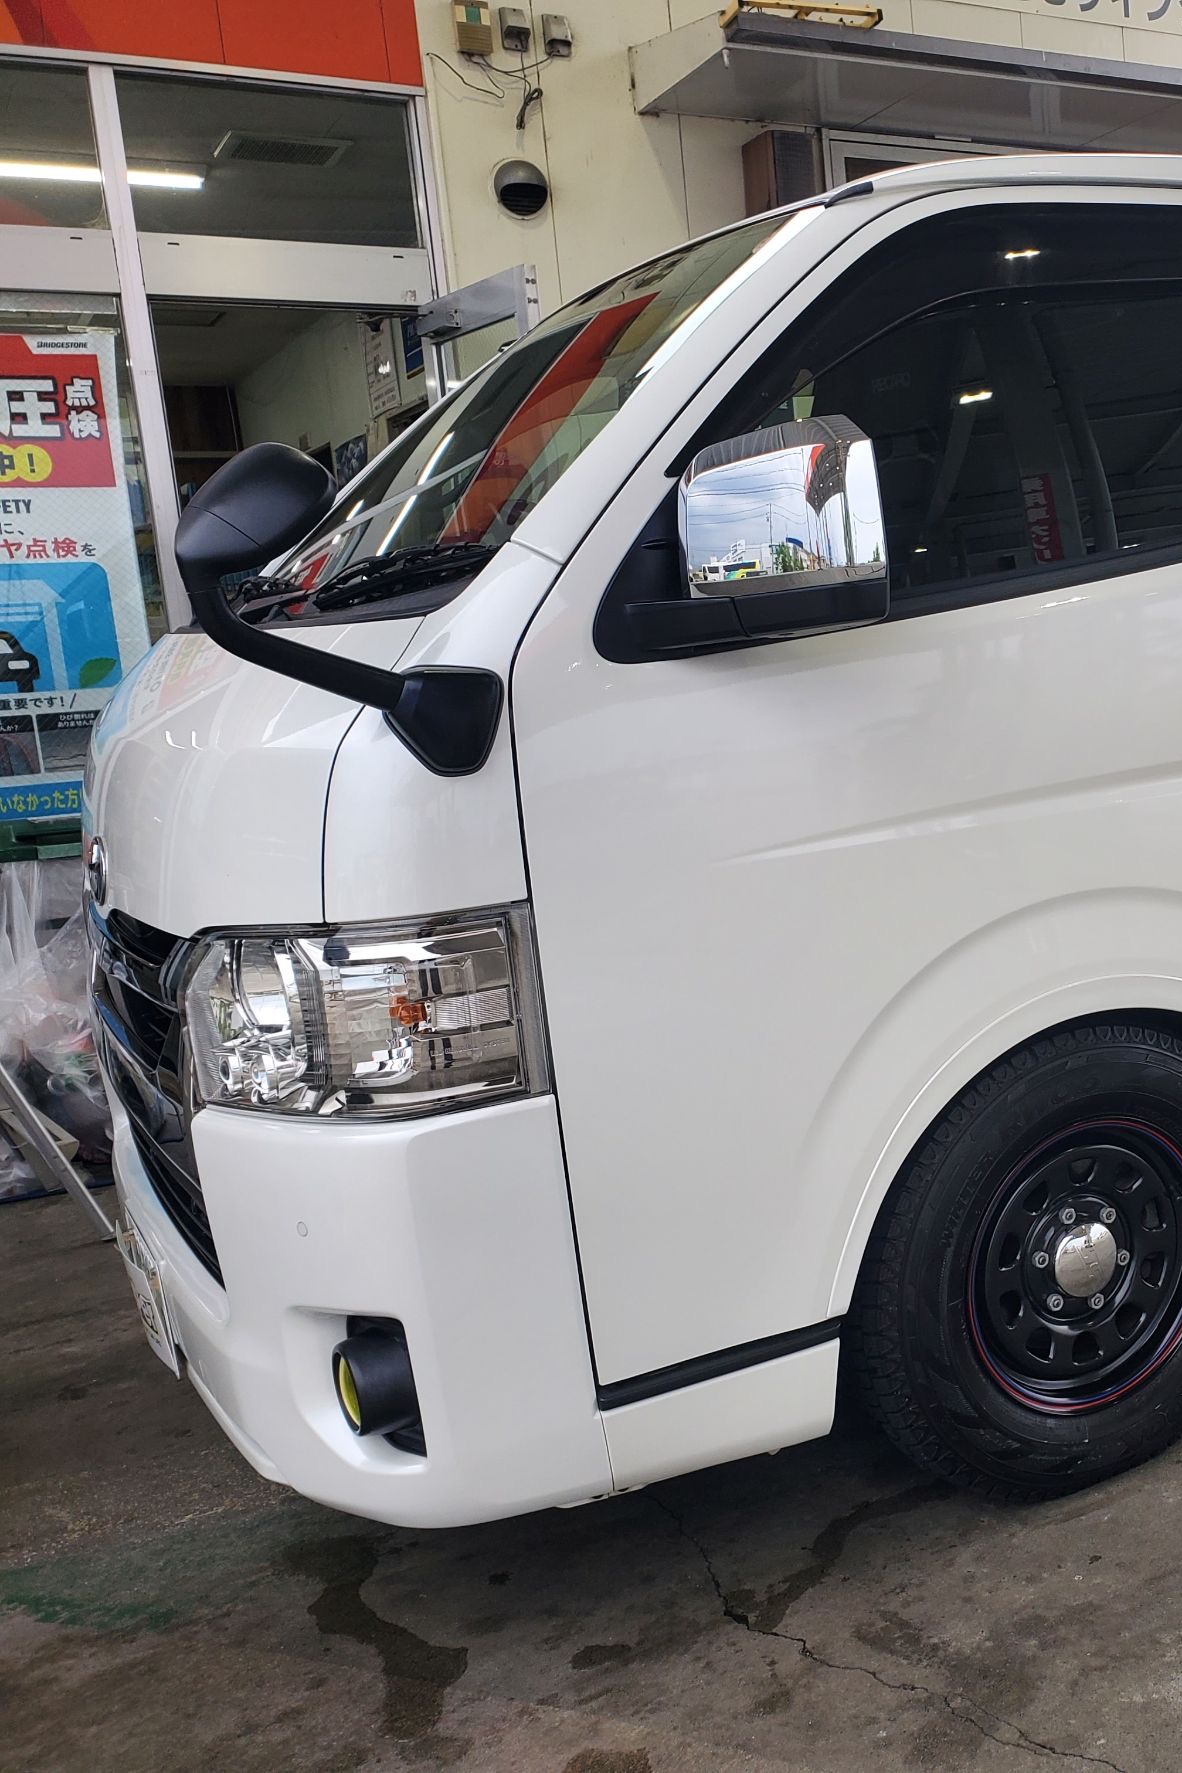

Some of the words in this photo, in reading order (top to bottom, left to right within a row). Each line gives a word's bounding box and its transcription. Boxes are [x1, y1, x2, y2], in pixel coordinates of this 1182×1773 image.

[37, 341, 88, 349] BRIDGESTONE
[65, 377, 100, 439] 点検
[0, 499, 31, 514] ETY
[0, 537, 96, 559] ヤ点検を
[0, 788, 82, 813] いなかった方
